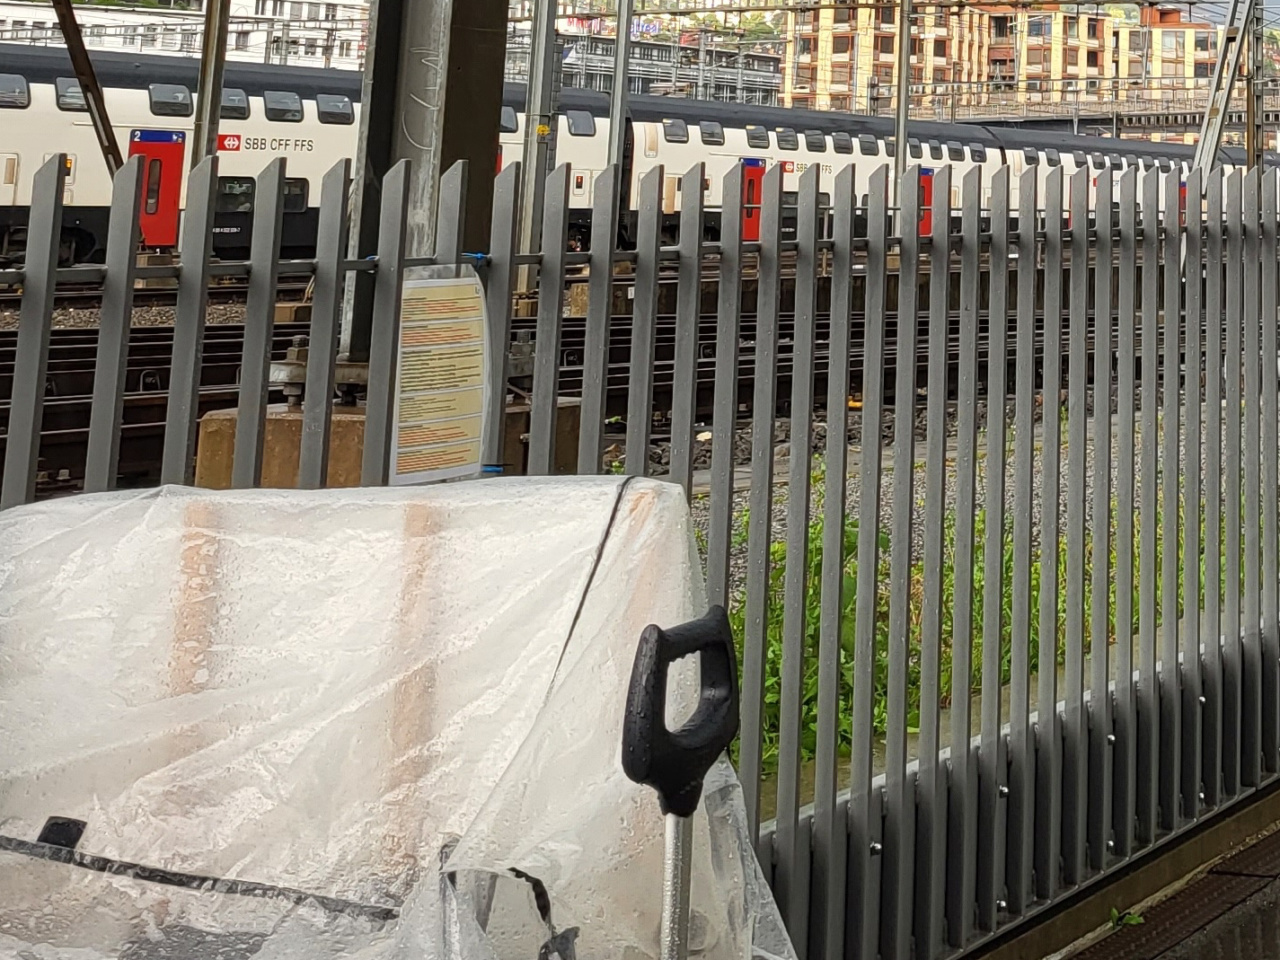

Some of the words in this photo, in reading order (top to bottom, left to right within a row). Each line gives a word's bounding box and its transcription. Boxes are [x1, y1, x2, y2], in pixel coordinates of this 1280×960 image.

[133, 131, 141, 141] 2
[244, 137, 267, 150] SBB
[270, 138, 290, 151] CFF
[294, 139, 314, 151] FFS
[821, 165, 832, 174] FFS
